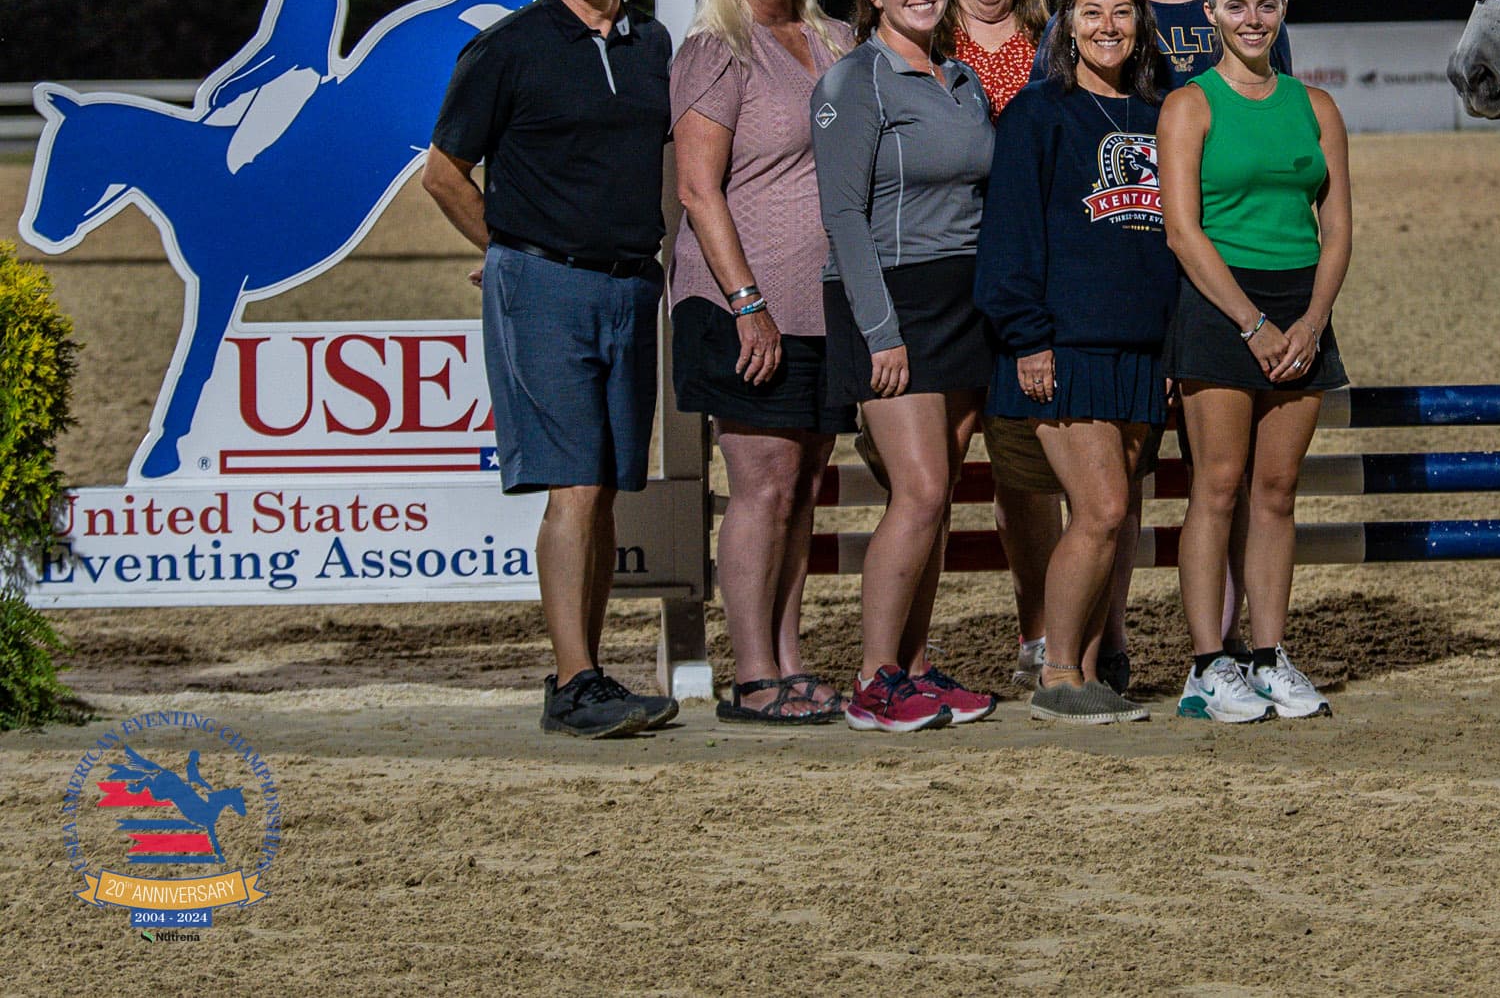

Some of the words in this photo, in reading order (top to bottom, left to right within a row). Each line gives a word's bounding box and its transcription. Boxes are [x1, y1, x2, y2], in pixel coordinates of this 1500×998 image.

[224, 334, 497, 437] USE
[252, 491, 429, 535] States
[36, 539, 300, 591] Eventing
